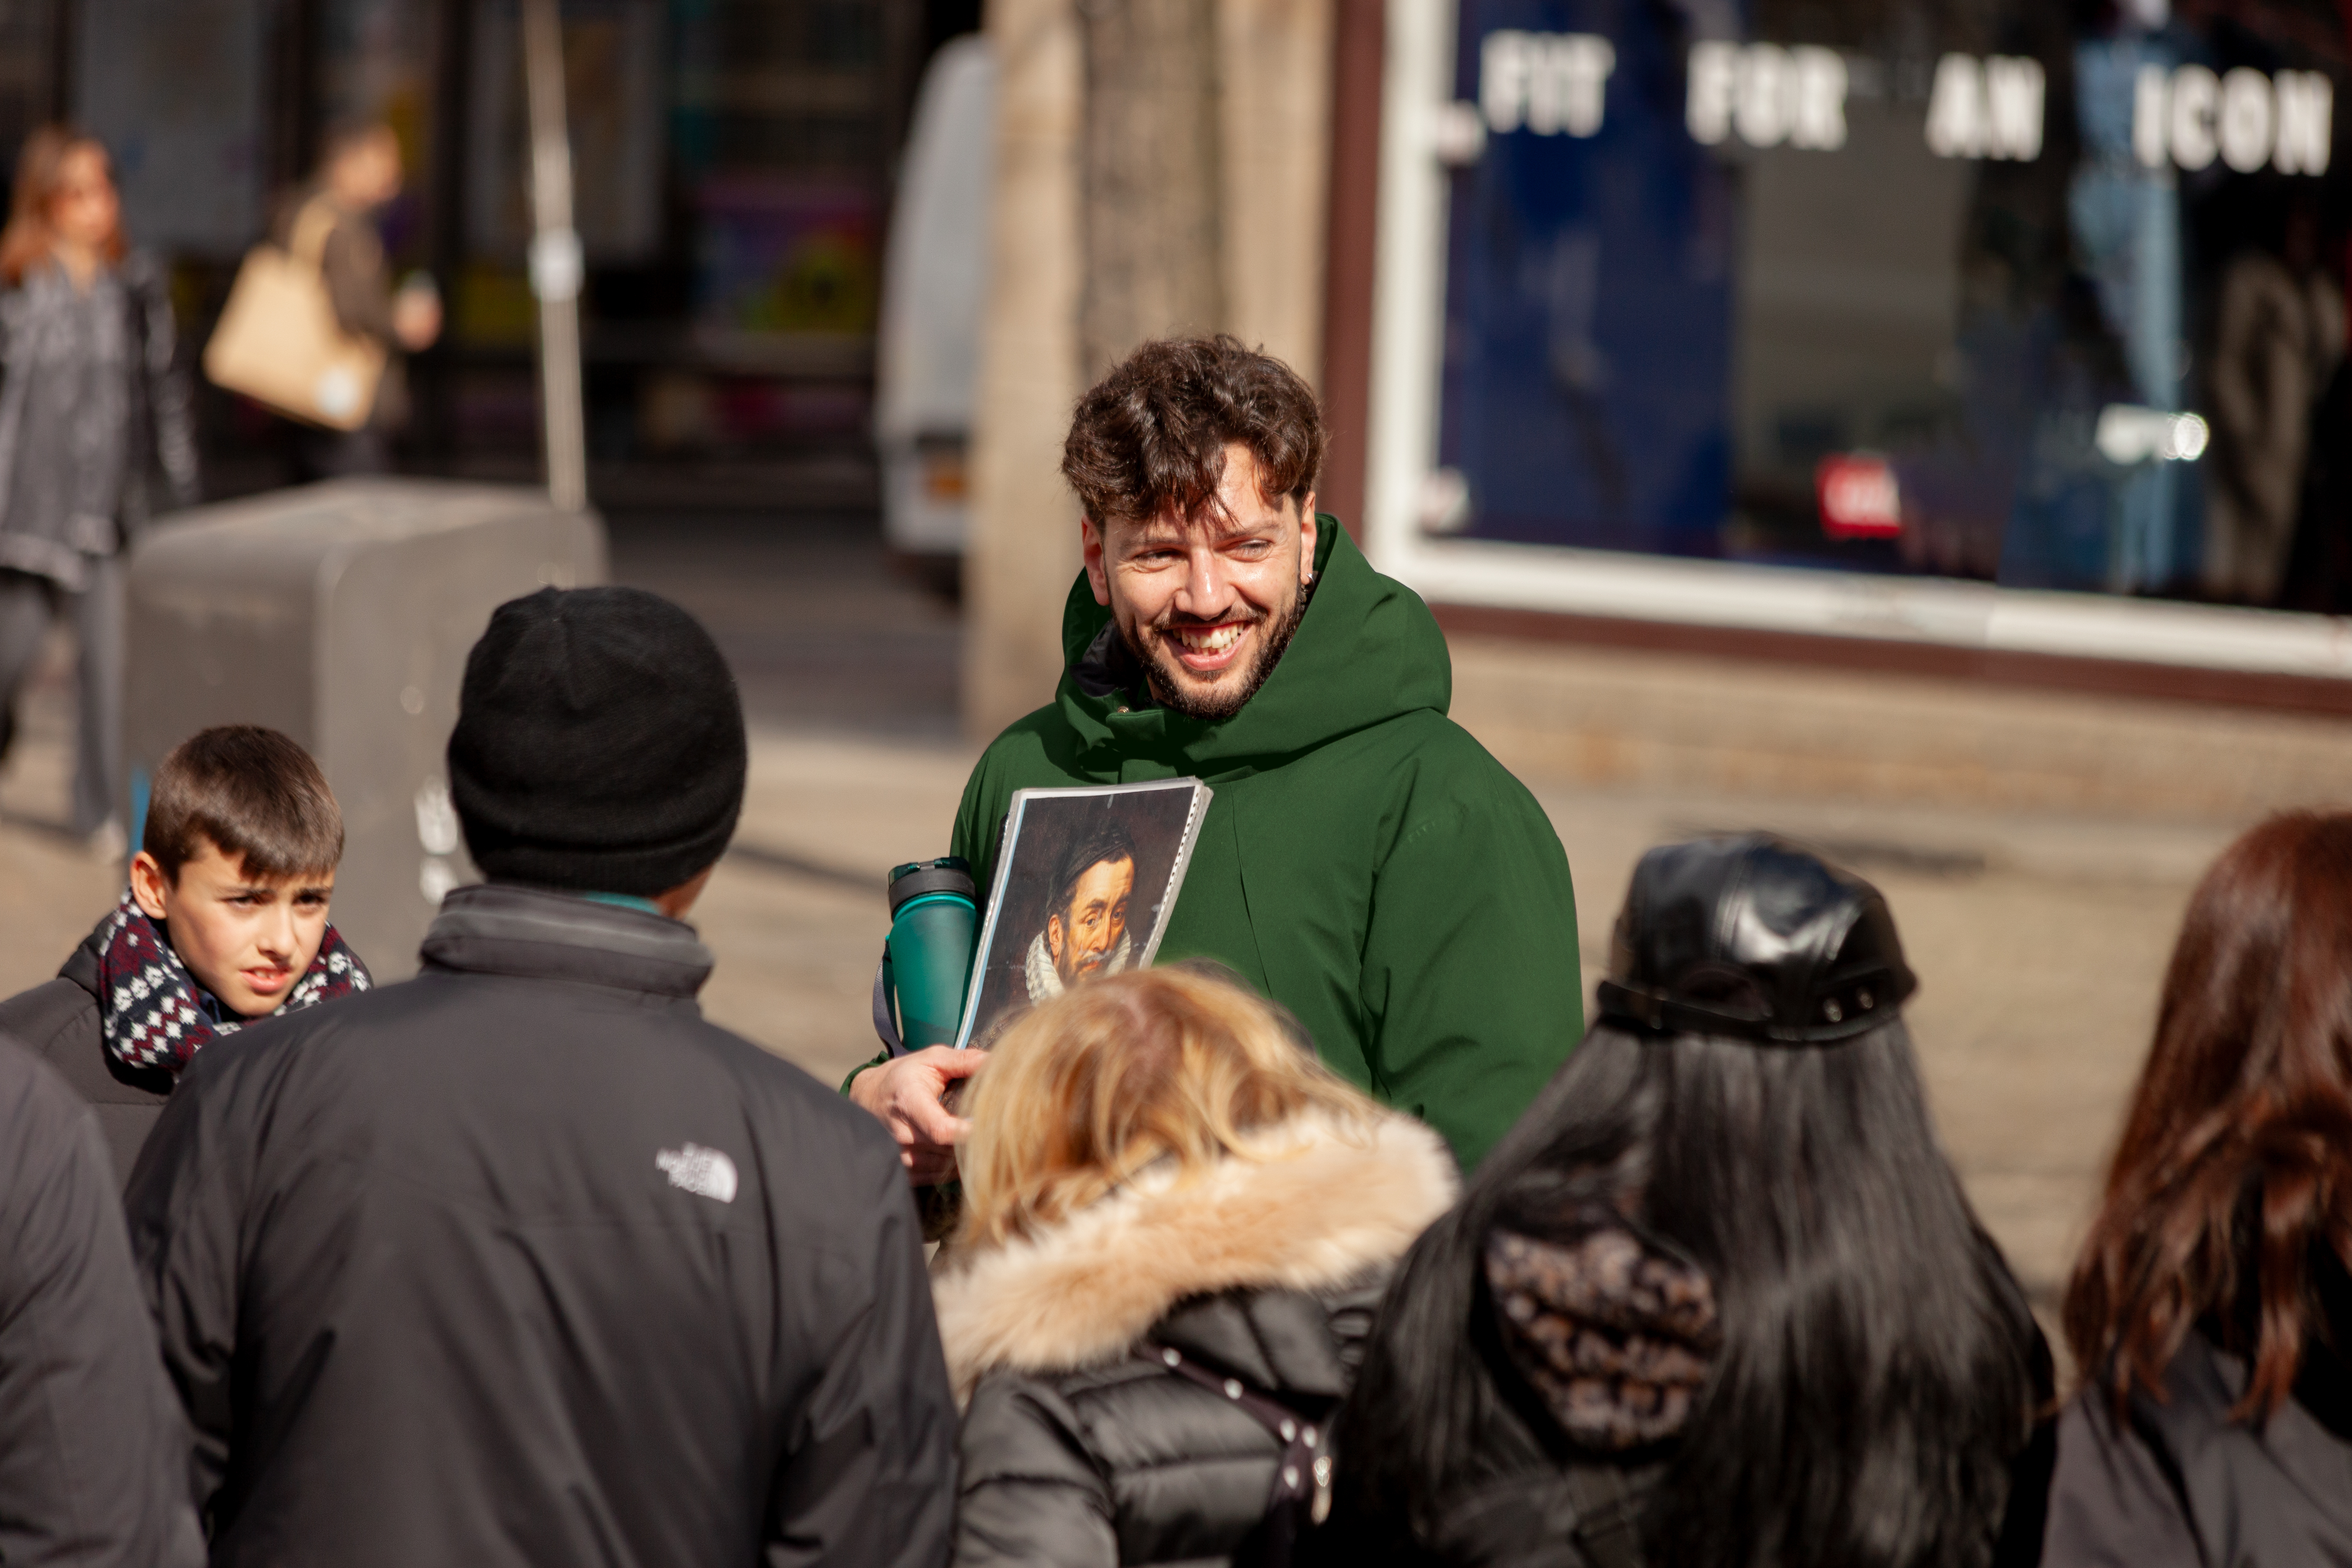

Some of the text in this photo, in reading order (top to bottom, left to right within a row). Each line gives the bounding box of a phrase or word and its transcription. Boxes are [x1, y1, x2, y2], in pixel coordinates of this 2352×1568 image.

[1481, 32, 2332, 175] FIT FOR AN ICON
